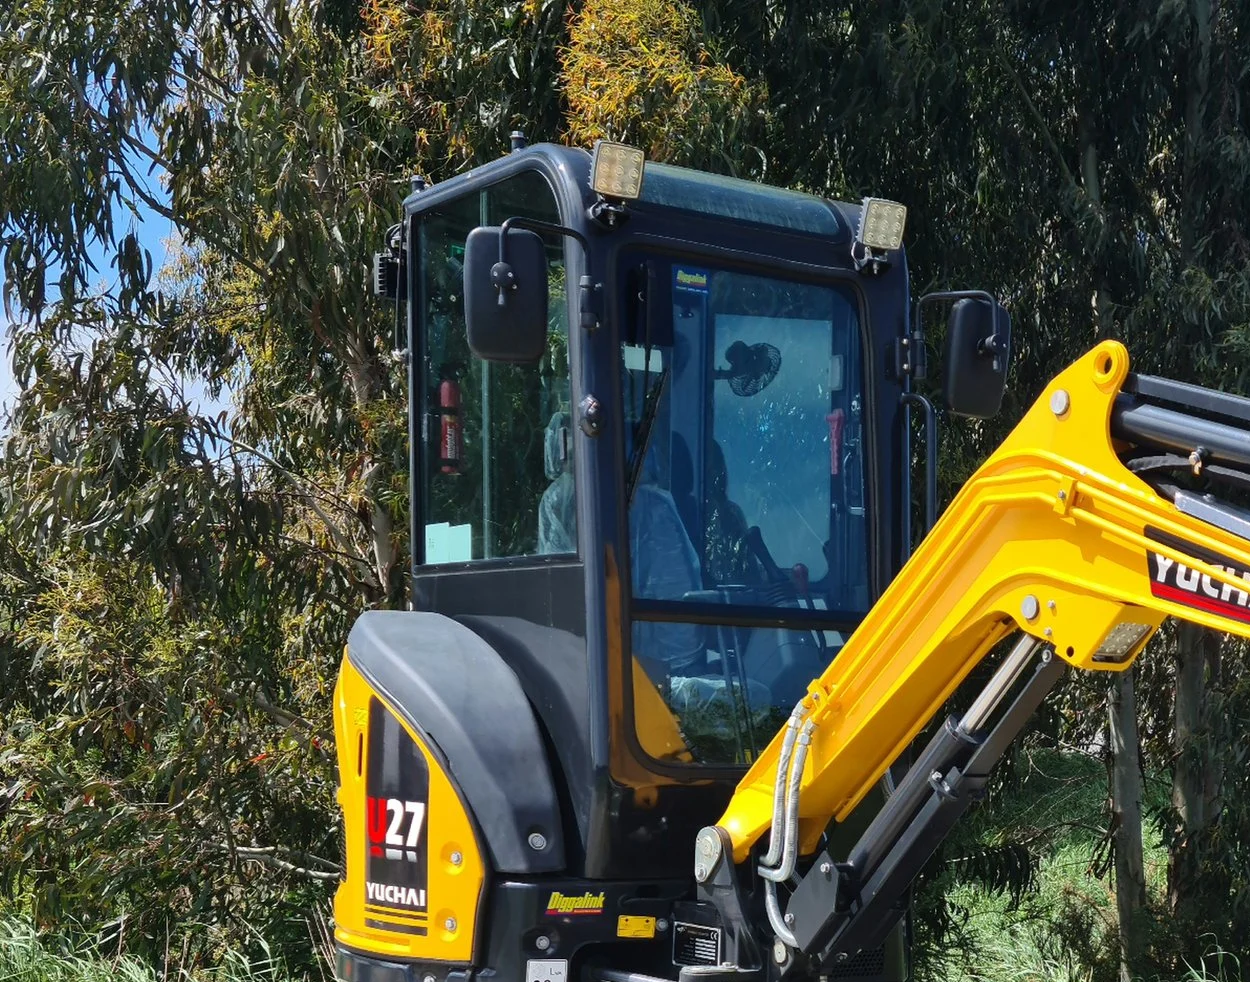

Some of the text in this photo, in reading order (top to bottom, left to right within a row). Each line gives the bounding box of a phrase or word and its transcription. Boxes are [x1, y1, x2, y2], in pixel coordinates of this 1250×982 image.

[367, 797, 425, 847] U27
[366, 882, 426, 906] YUCHAI
[547, 891, 605, 912] Diggalink
